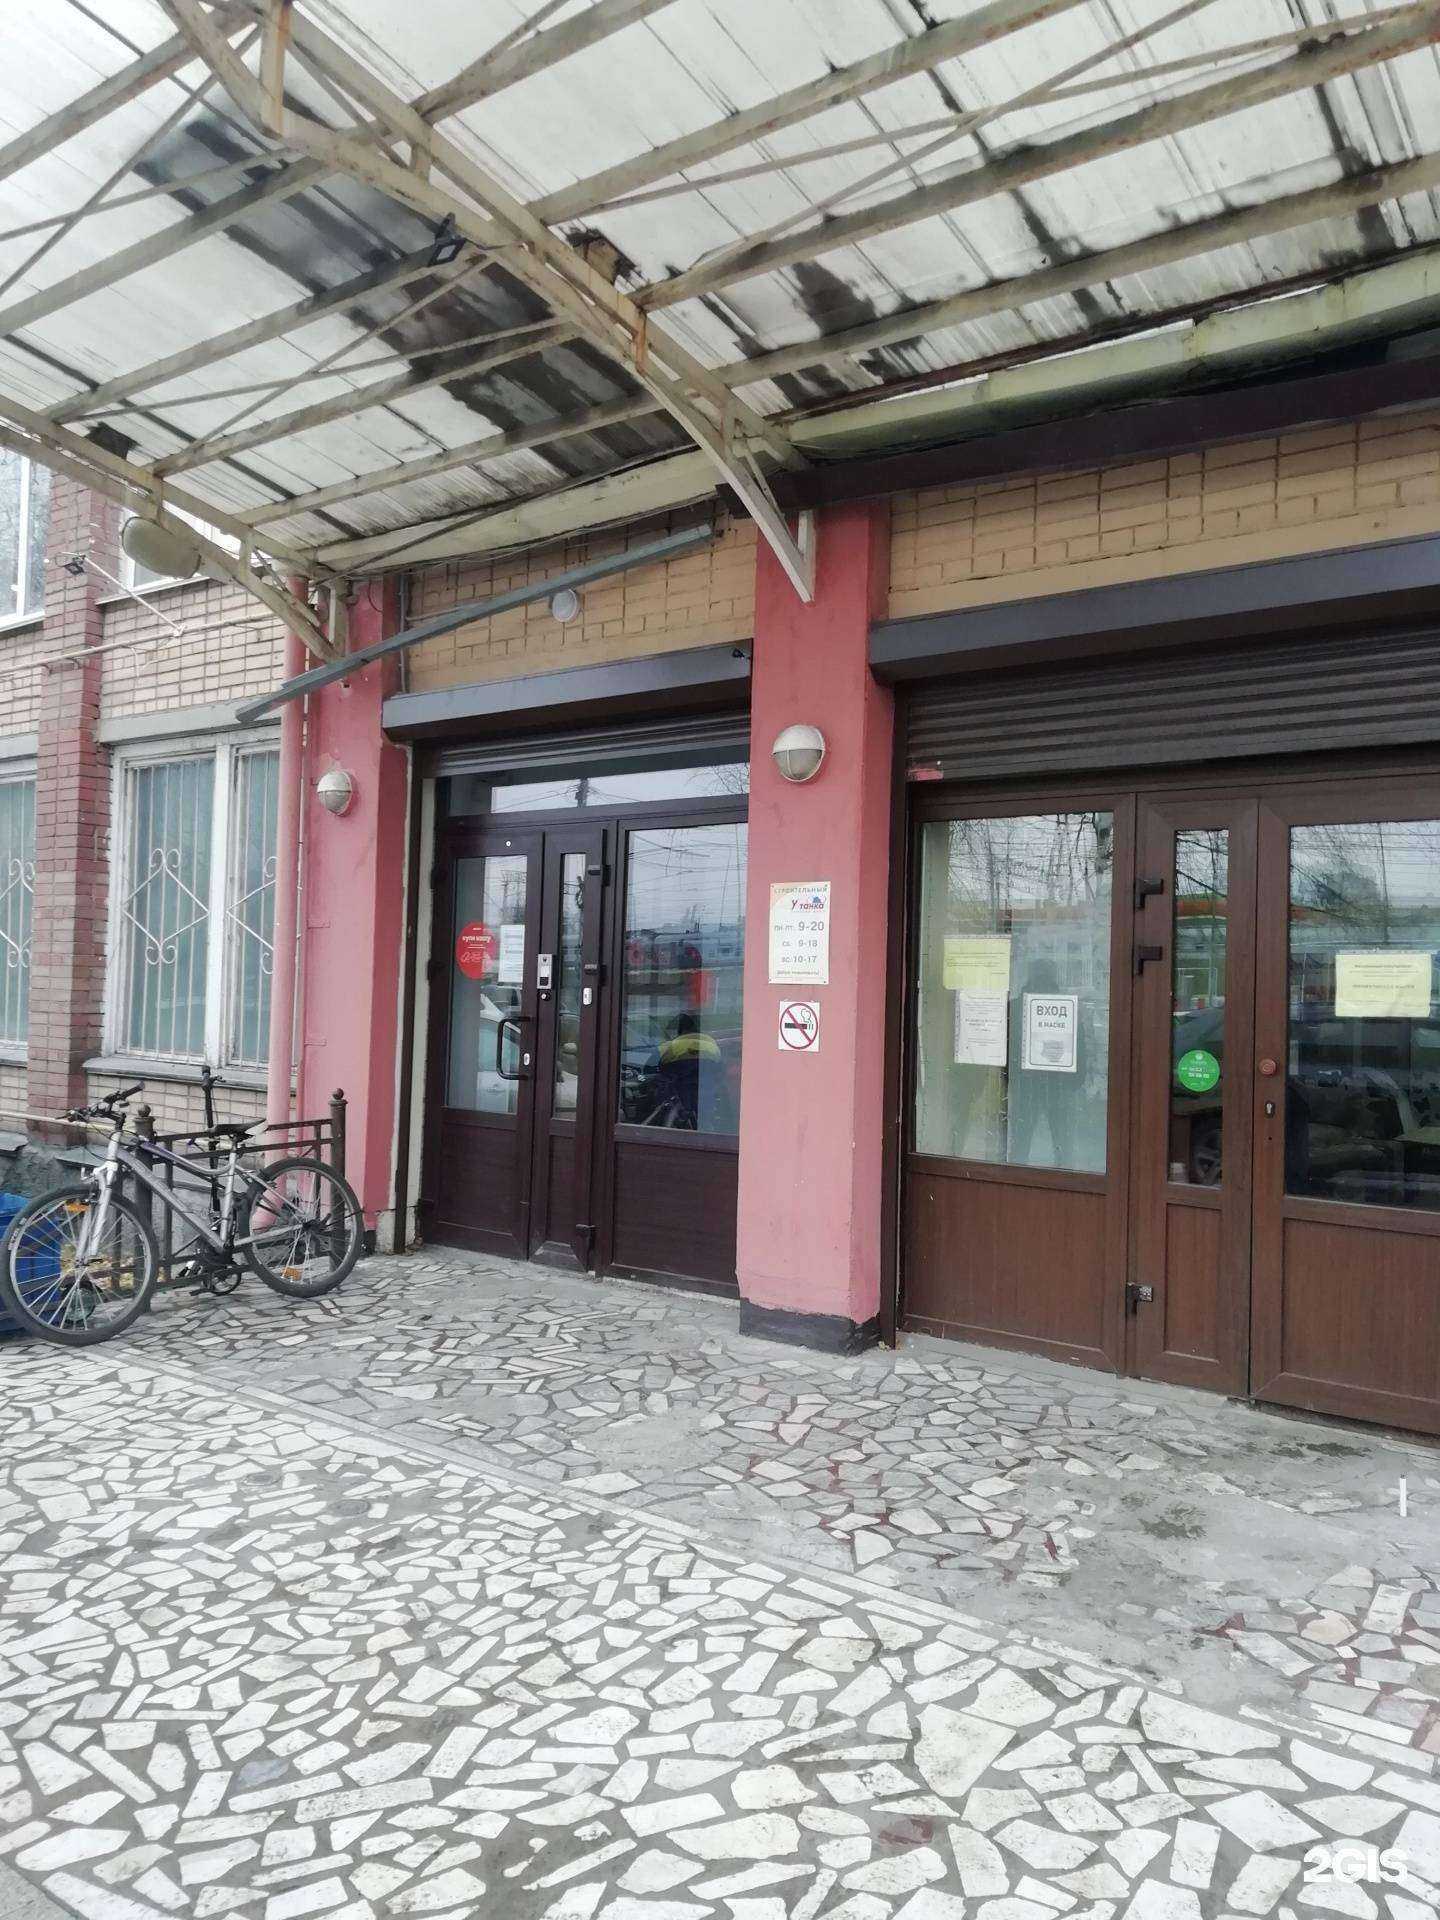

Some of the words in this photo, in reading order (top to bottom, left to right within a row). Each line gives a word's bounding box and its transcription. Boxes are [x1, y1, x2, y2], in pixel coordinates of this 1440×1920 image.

[798, 921, 825, 931] 9-20
[798, 939, 818, 947] 9-18
[793, 955, 817, 963] 10-17
[1036, 1005, 1068, 1018] ВХОД
[1044, 1021, 1066, 1029] МАСКЕ
